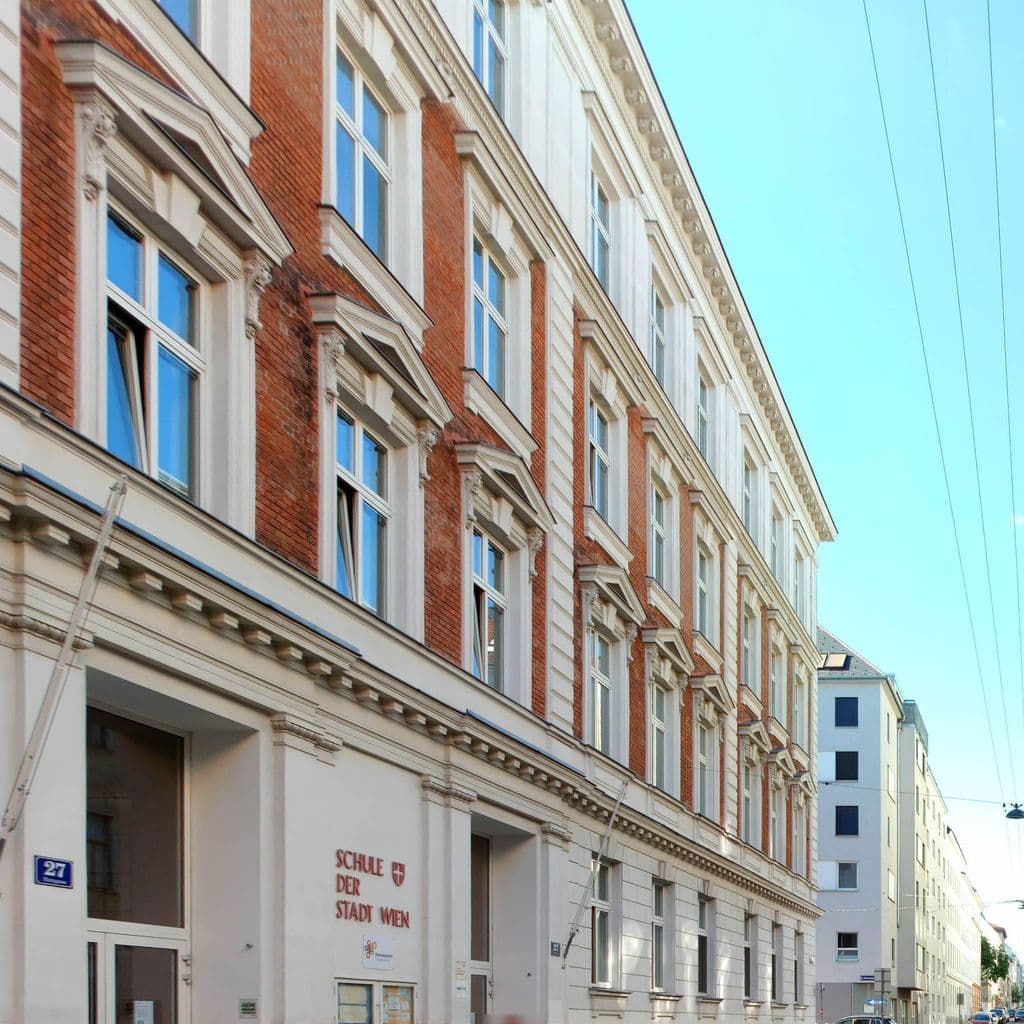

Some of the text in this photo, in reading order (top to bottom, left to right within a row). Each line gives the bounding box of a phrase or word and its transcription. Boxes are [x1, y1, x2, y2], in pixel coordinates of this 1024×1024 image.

[43, 861, 66, 878] 27
[336, 848, 384, 876] SCHULE
[336, 873, 360, 896] DER
[336, 900, 410, 928] STADT WIEN
